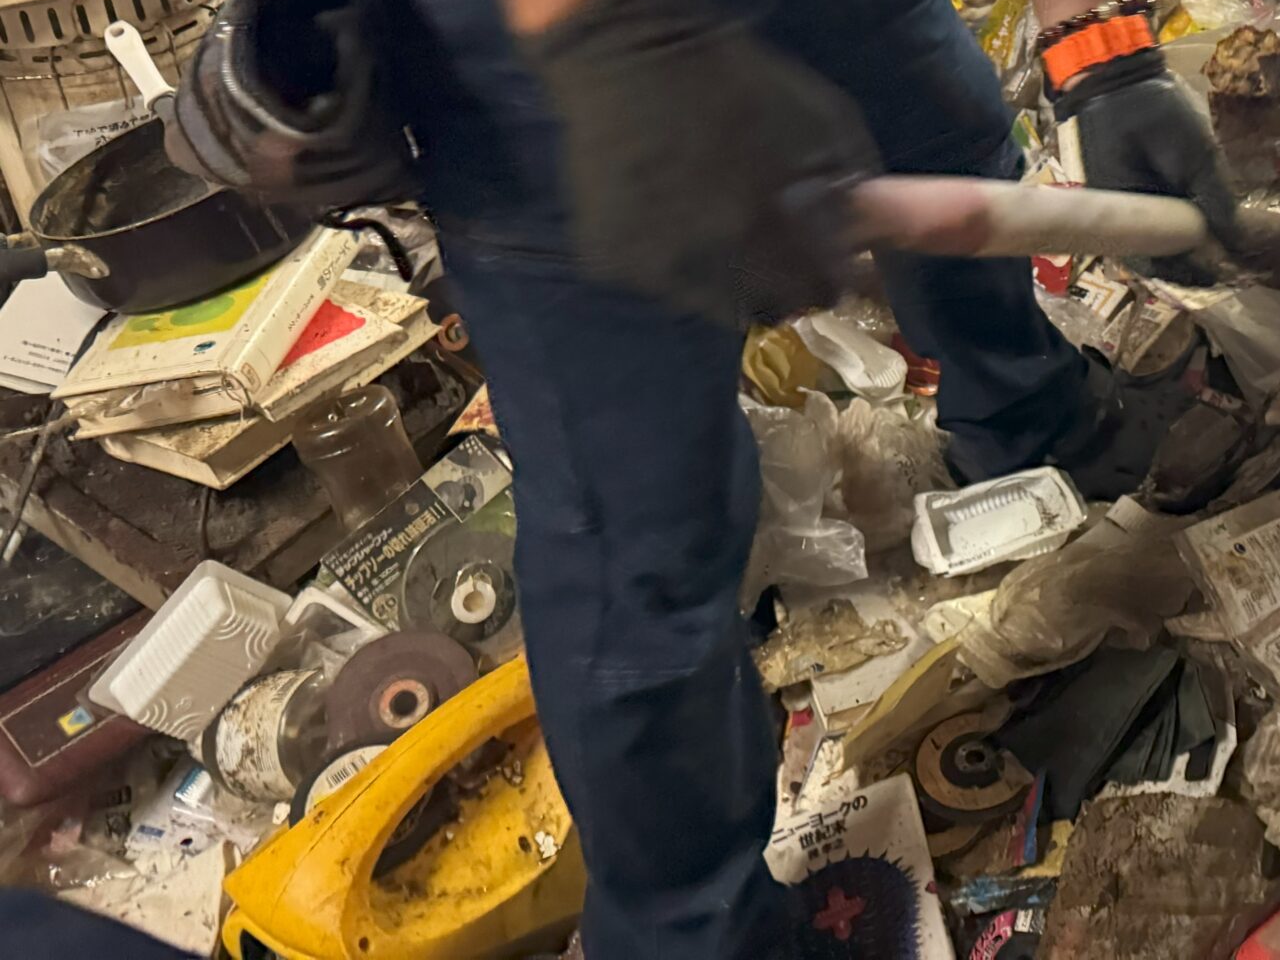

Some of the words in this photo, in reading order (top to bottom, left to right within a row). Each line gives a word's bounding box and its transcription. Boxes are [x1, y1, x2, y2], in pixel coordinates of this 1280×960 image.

[771, 795, 868, 844] ニューヨークの
